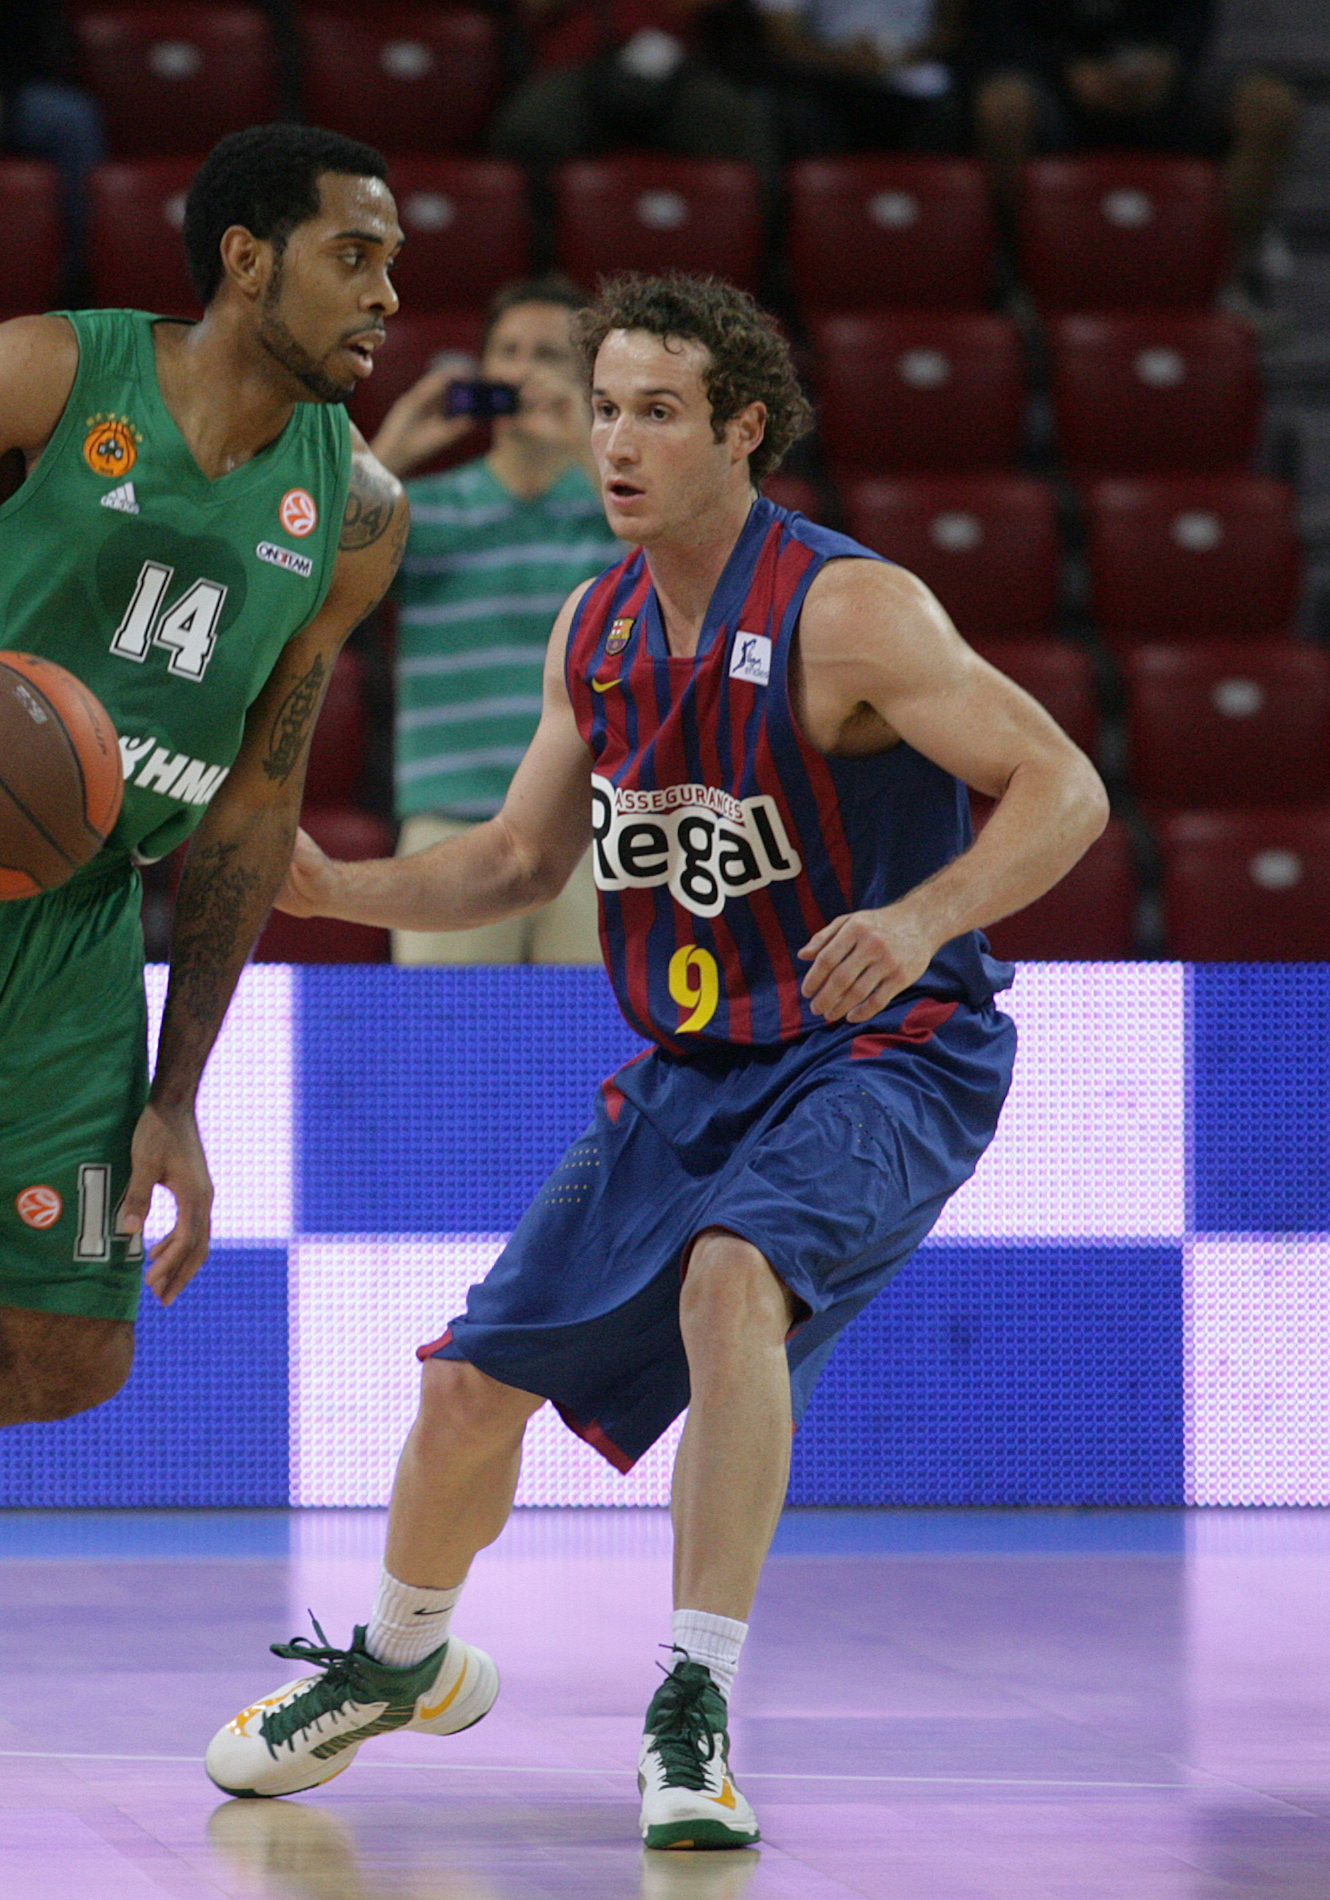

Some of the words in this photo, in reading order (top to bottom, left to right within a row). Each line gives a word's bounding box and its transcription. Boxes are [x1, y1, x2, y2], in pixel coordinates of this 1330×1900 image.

[109, 559, 228, 683] 14
[592, 788, 791, 906] Regal
[615, 786, 744, 820] ASSEGURANCES
[668, 944, 719, 1034] 9
